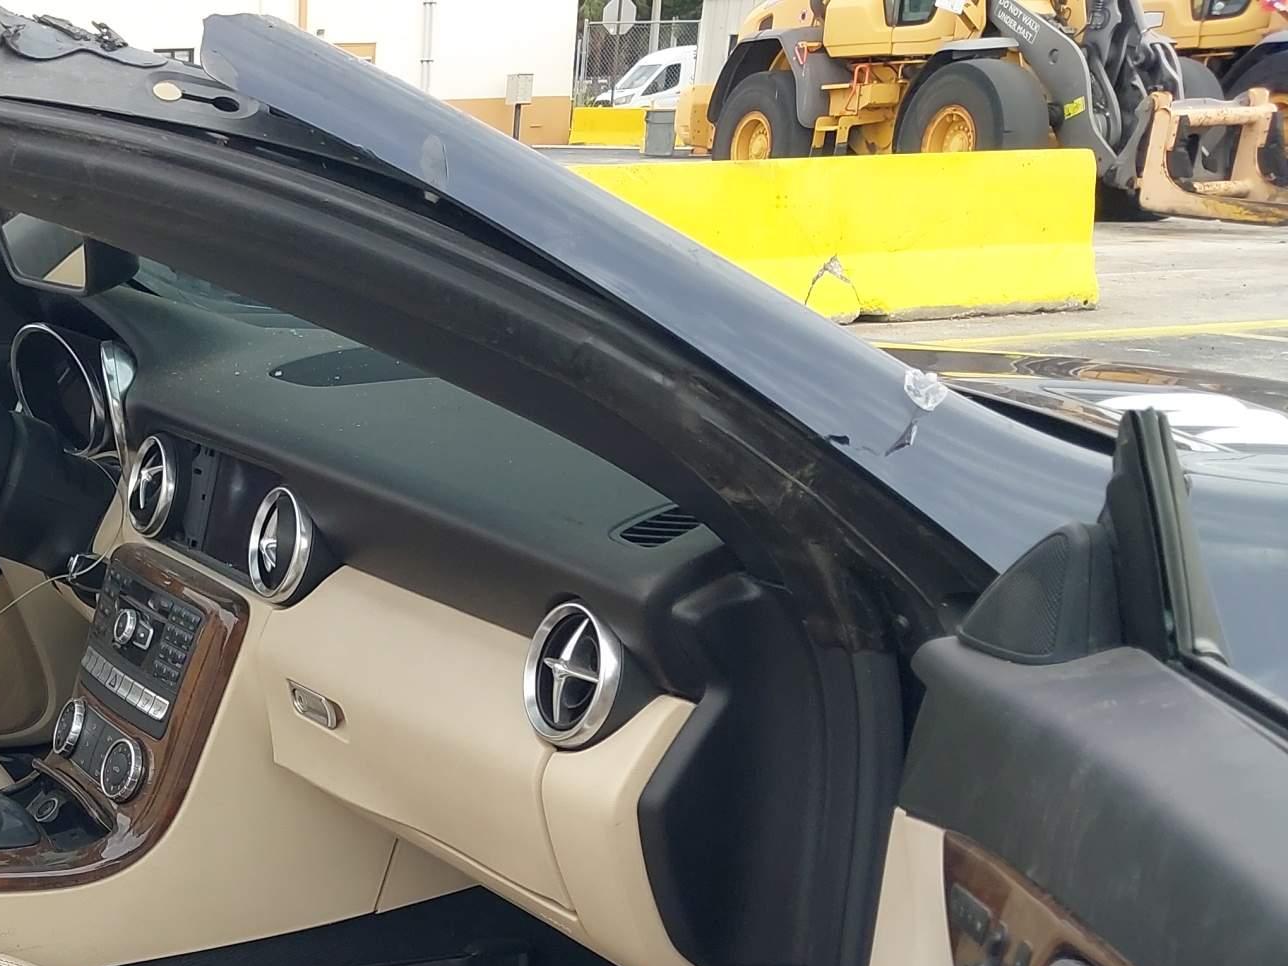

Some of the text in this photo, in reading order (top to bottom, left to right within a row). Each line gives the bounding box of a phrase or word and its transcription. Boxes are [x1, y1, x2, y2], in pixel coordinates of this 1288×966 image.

[998, 10, 1017, 30] UNDER
[999, 0, 1040, 31] DO NOT WALK
